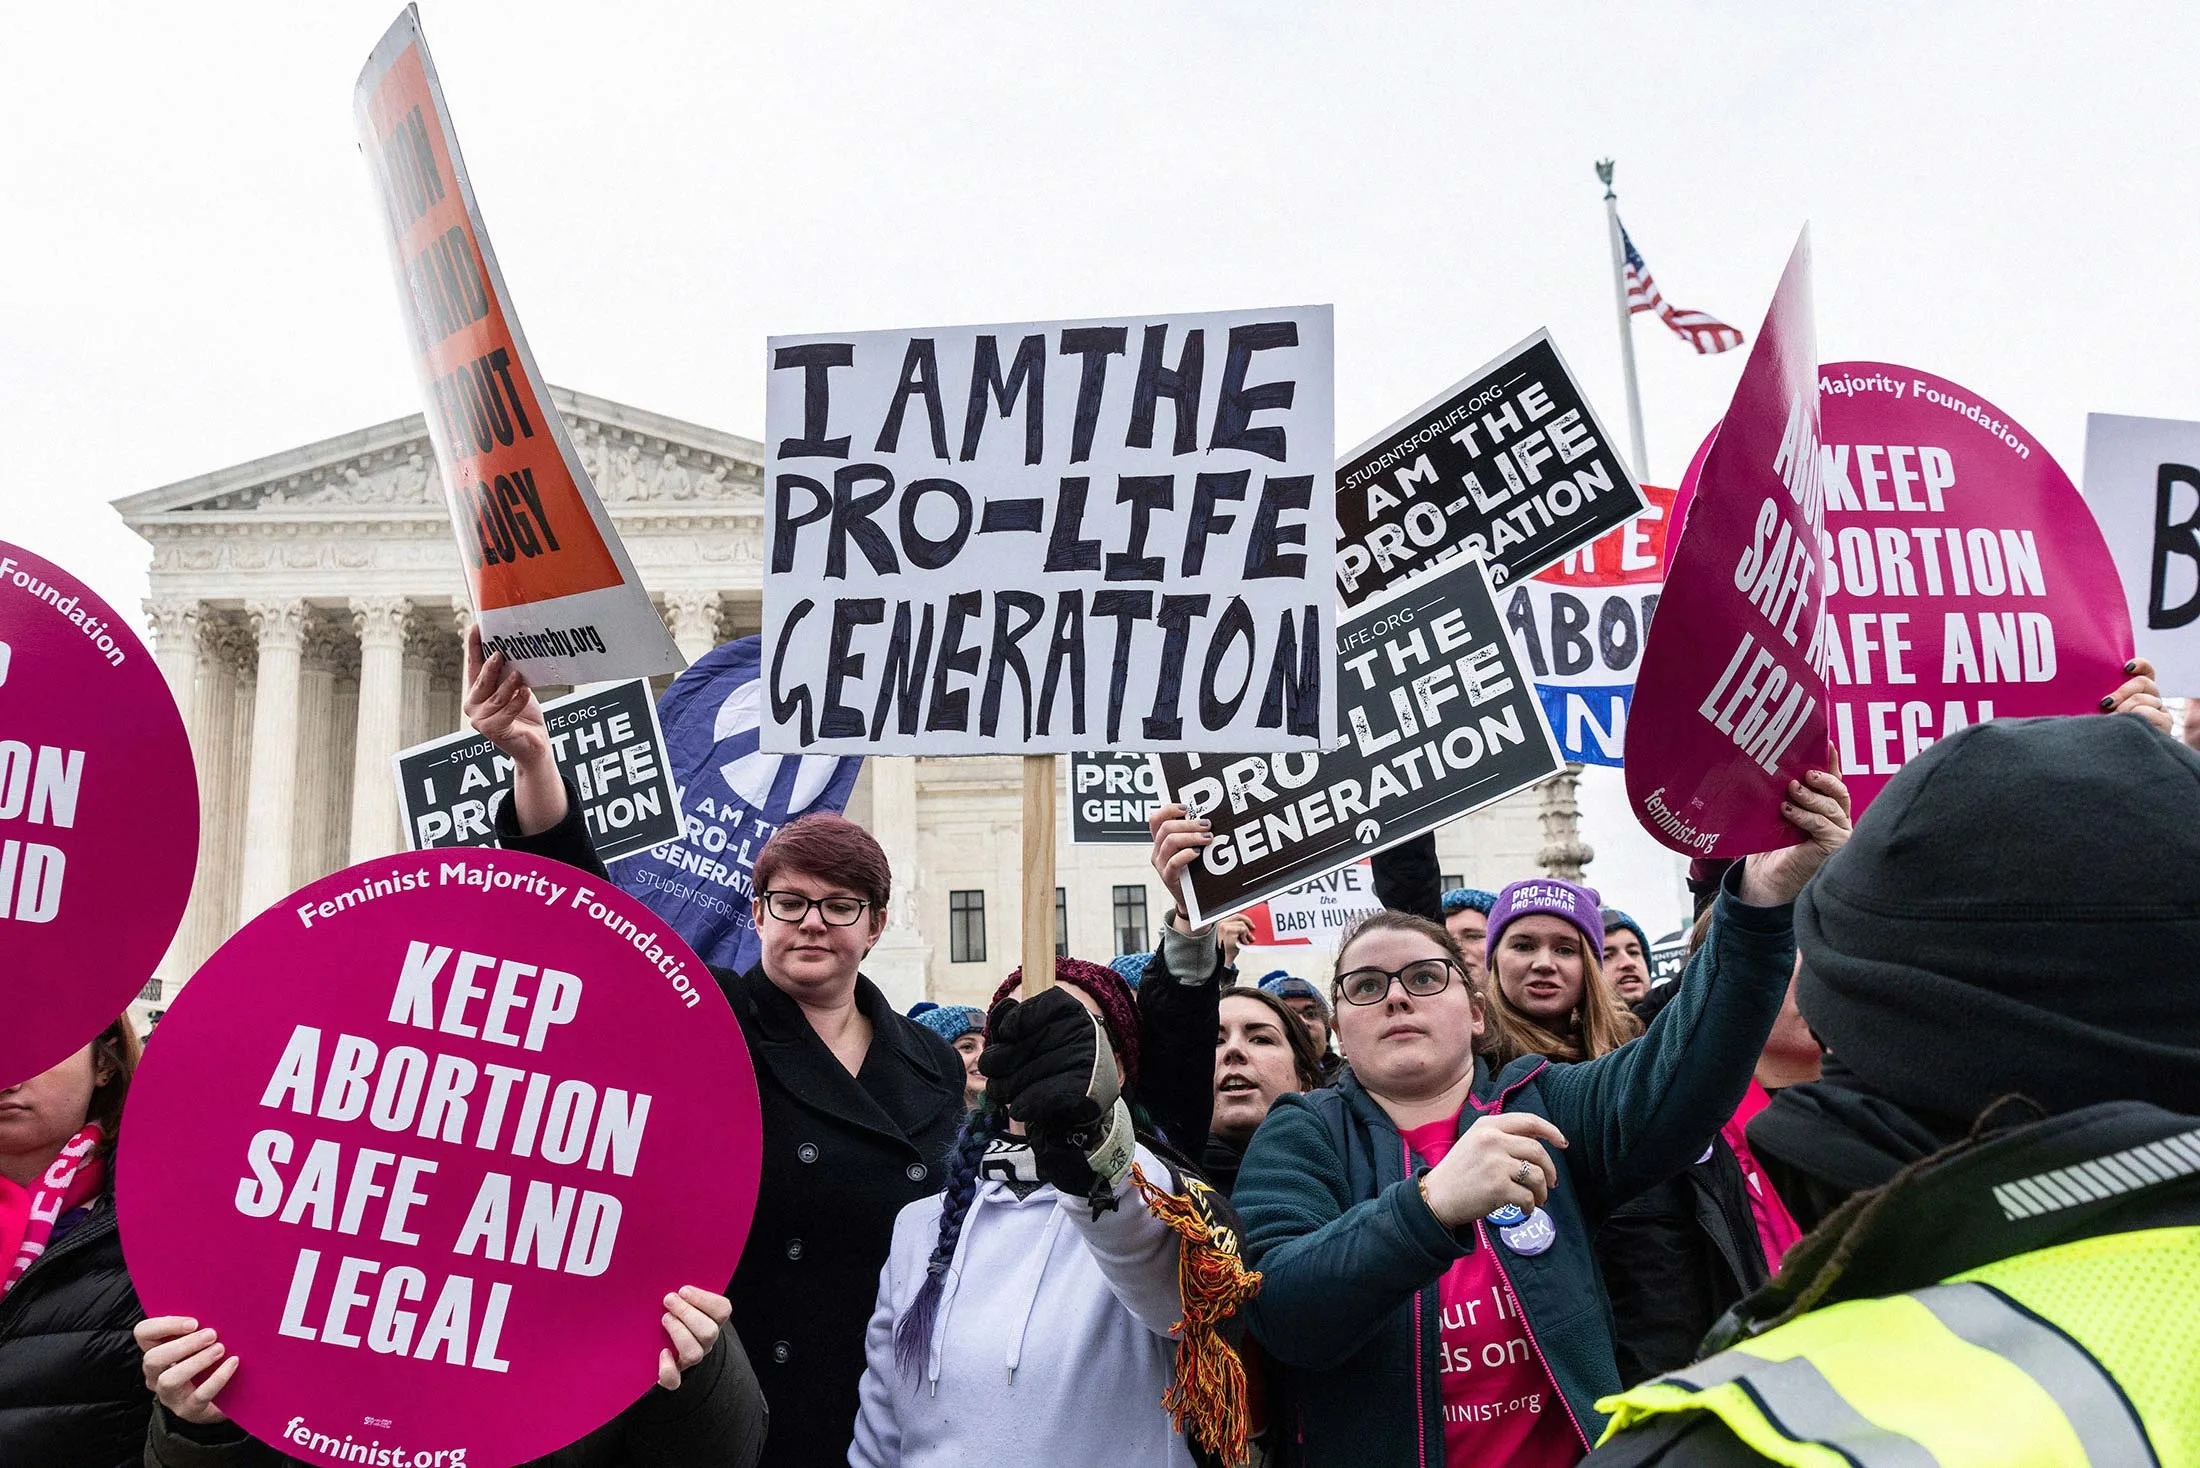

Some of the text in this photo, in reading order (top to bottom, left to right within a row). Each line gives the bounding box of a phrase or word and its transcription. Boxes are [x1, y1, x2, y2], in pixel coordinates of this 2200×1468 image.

[774, 321, 1299, 465] I AM THE
[1345, 384, 1503, 489] STUDENTSFORLIFE.ORG
[1912, 379, 2031, 461] Foundation
[1335, 407, 1598, 593] PRO-LIFE
[1366, 381, 1556, 521] AM THE
[1821, 444, 1956, 513] KEEP
[771, 463, 1314, 582] PRO-LIFE
[1365, 459, 1615, 602] ERATION
[1734, 497, 1815, 647] SAFE
[0, 558, 126, 667] Foundation
[770, 588, 1321, 748] GENERATION
[1344, 607, 1473, 690] THE
[1941, 612, 2058, 683] AND
[424, 777, 437, 805] I
[551, 711, 635, 762] THE
[1178, 642, 1515, 820] PRO-LIFE
[1698, 631, 1816, 776] LEGAL
[684, 813, 755, 869] RO-L
[696, 797, 745, 828] AM
[1202, 704, 1526, 876] GENERATION
[1644, 786, 1720, 854] feminist.org
[296, 862, 702, 1009] Feminist Majority Foundation
[1276, 910, 1317, 932] BABY
[1510, 896, 1575, 913] PRO-WOMAN
[1512, 885, 1576, 904] PRO-LIFE
[387, 939, 584, 1053] KEEP
[259, 1024, 653, 1178] ABORTION
[234, 1129, 624, 1277] SAFE AND
[278, 1248, 513, 1374] LEGAL
[1482, 1338, 1530, 1367] on
[282, 1416, 467, 1468] feminist.org
